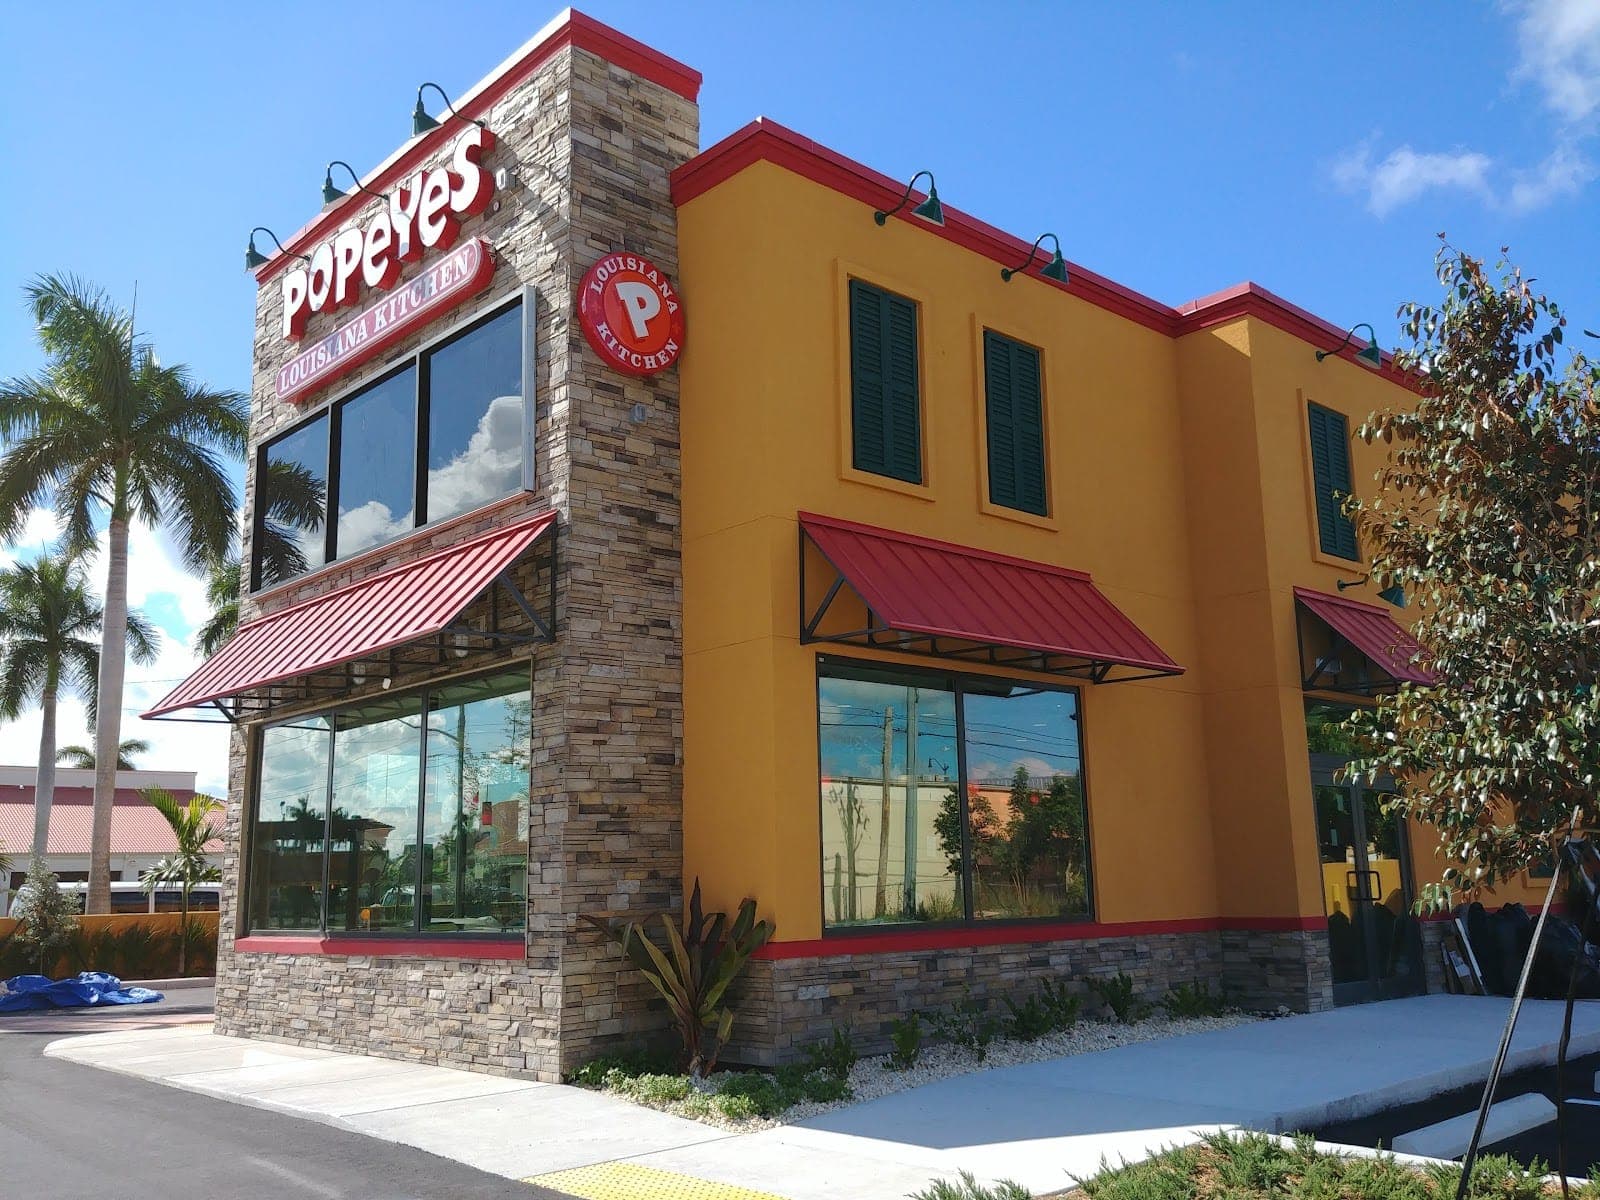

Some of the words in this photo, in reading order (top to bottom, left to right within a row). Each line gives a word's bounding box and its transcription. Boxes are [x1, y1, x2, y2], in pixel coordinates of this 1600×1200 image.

[590, 256, 678, 314] LOUISIANA
[615, 281, 661, 338] P
[279, 319, 368, 393] LOUISIANA
[373, 249, 471, 335] KITCHEN
[596, 321, 679, 369] KITCHEN
